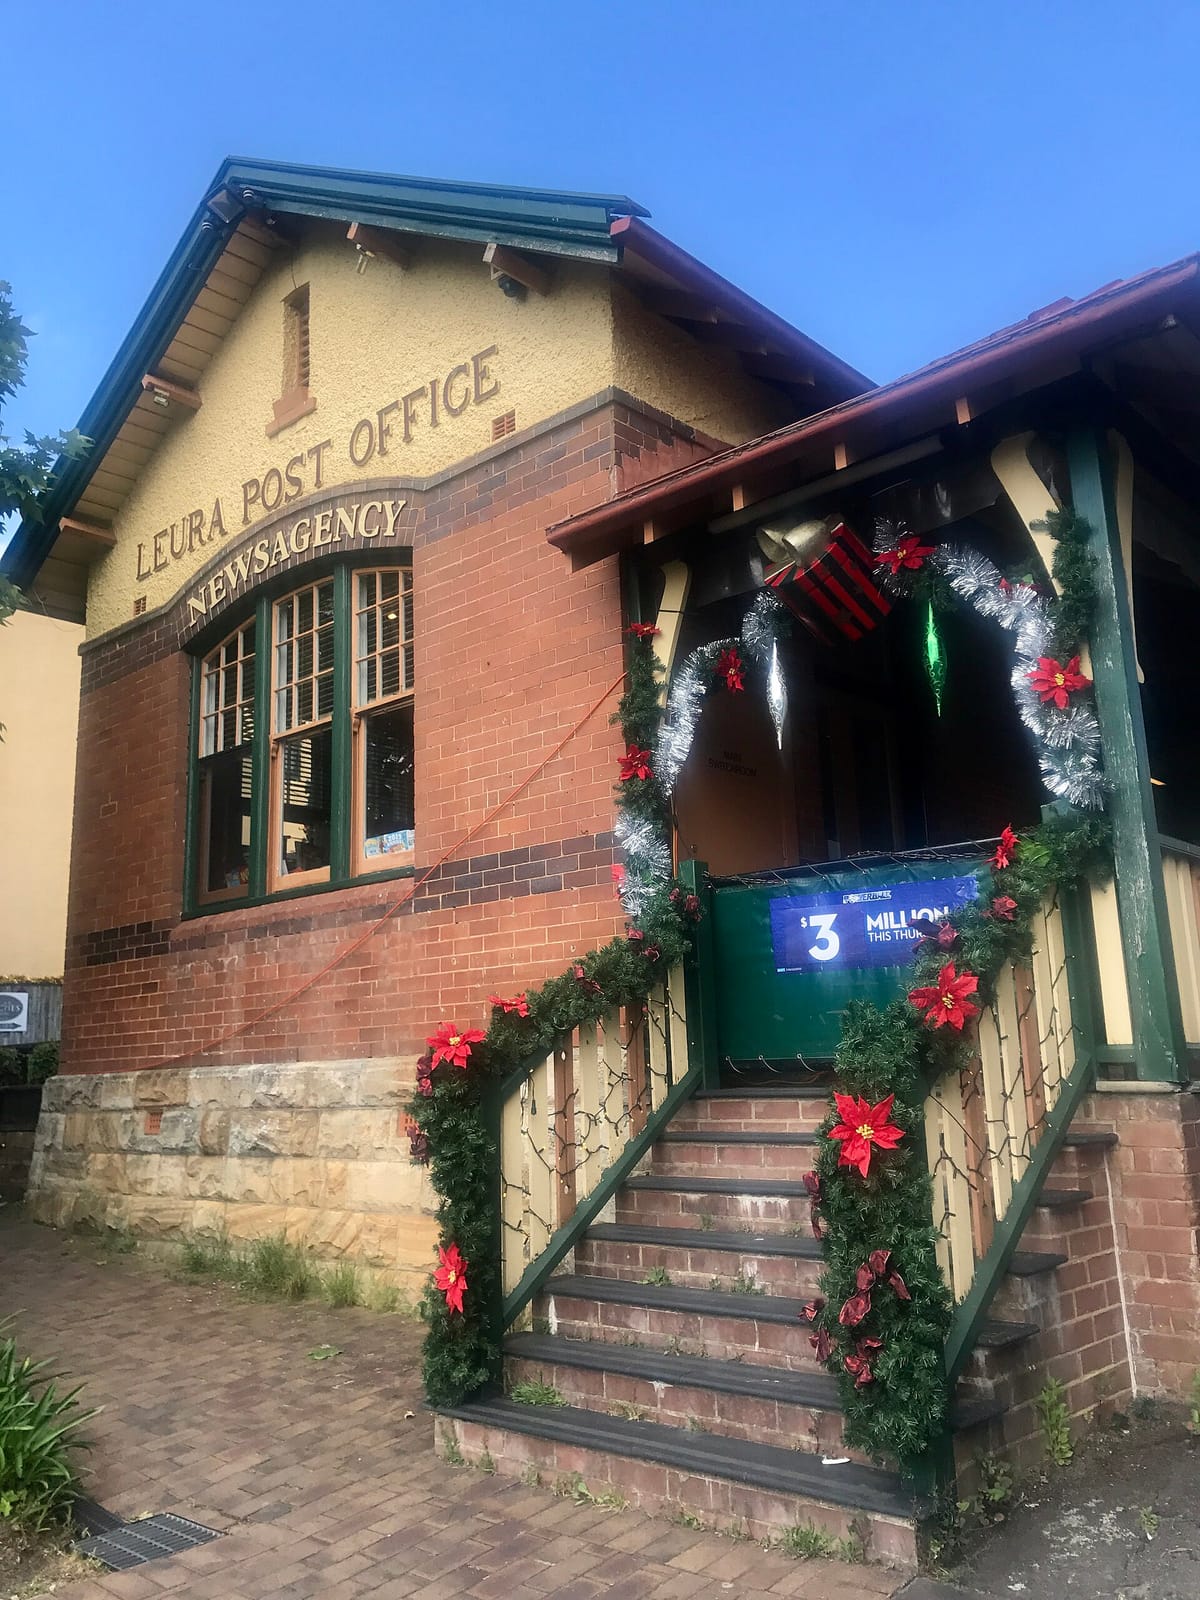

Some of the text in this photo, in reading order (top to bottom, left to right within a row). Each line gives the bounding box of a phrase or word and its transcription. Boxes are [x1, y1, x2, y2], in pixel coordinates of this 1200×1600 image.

[136, 344, 501, 581] LEURA POST OFFICE
[186, 500, 407, 627] NEWSAGENCY
[867, 930, 892, 943] THIS
